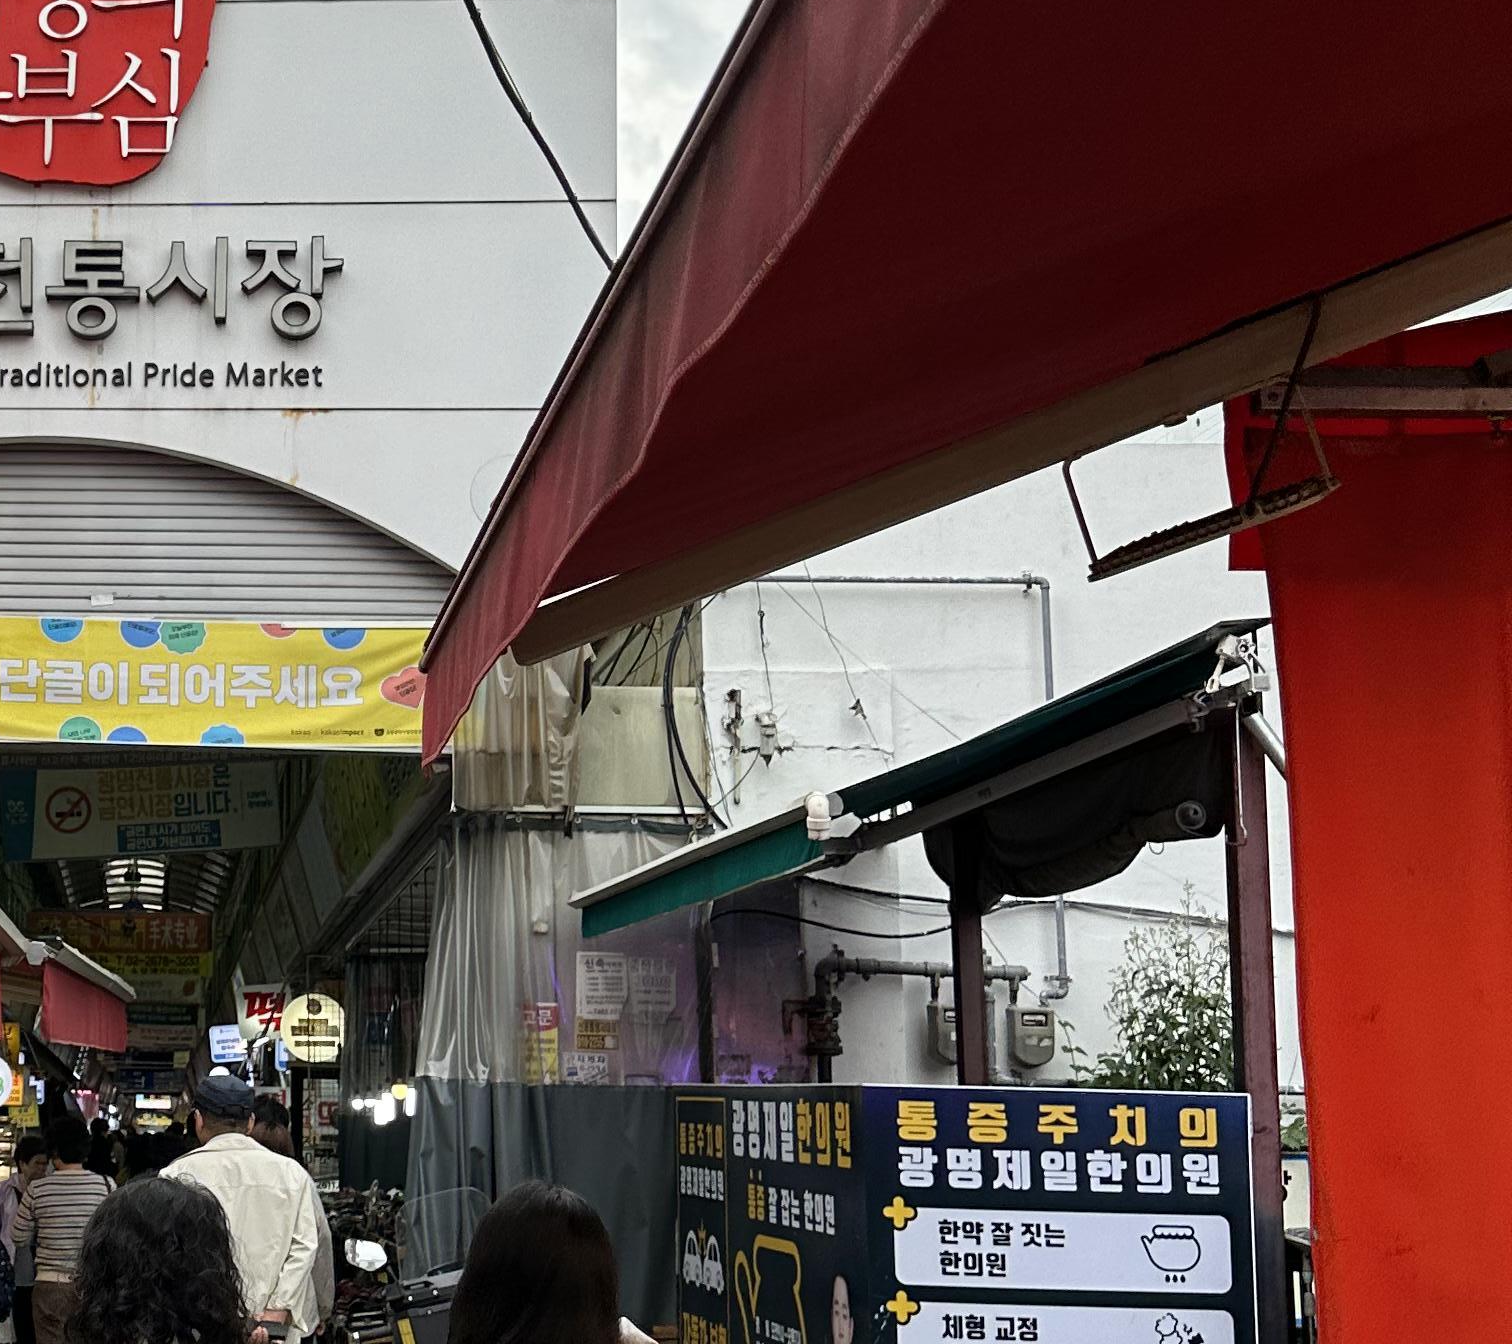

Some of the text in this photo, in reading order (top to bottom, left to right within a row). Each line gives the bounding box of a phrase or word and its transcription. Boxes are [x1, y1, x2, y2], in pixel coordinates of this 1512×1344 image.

[144, 361, 215, 388] Pride
[226, 361, 324, 389] Market
[138, 662, 364, 709] 되어주세요
[679, 1122, 724, 1159] 통증주치의
[731, 1098, 852, 1169] 광명제일한의원
[897, 1099, 1219, 1148] 통증주치의
[897, 1146, 1220, 1195] 광명제일한의원
[747, 1183, 836, 1237] 통증 잘 잡는 한의원
[938, 1219, 1067, 1248] 한약 잘 짓는
[939, 1250, 1008, 1278] 한의원
[942, 1314, 1039, 1342] 체형 교정
